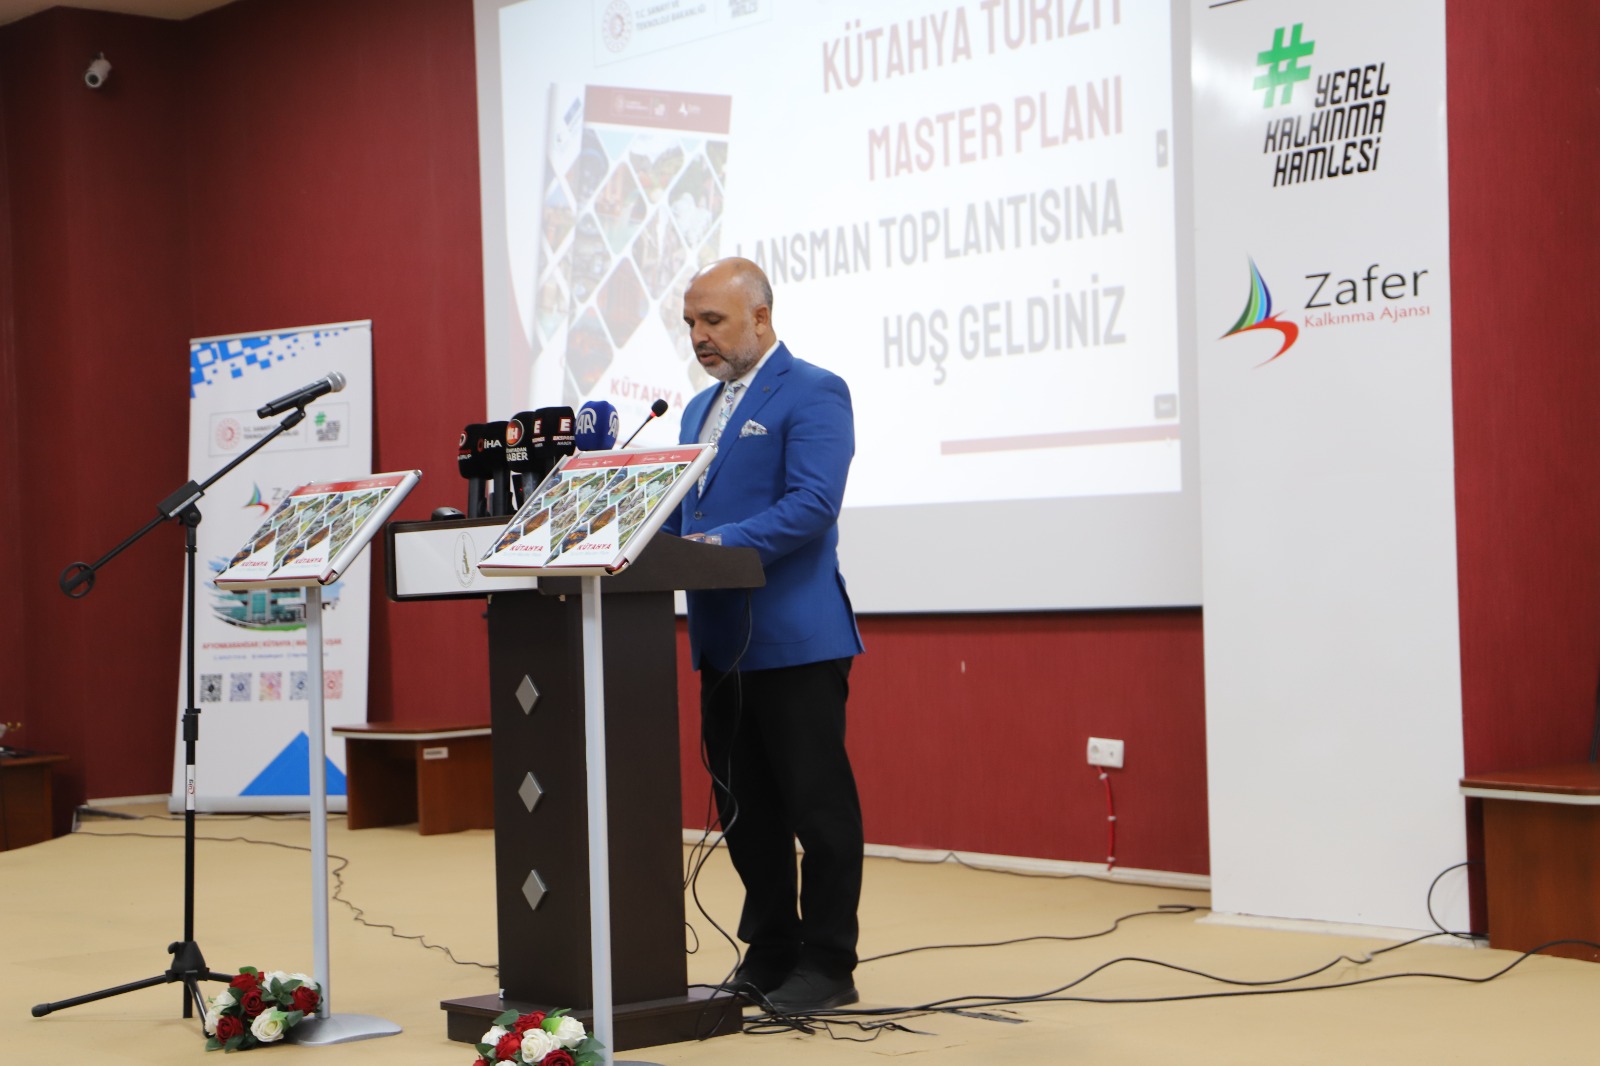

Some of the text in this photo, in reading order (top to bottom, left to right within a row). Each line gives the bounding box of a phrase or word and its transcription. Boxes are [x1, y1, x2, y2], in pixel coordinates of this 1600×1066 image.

[822, 4, 972, 94] KÜTAHYA
[1314, 62, 1390, 108] YEREL
[868, 75, 1124, 182] MASTER PLANI
[1263, 100, 1387, 154] KALKINMA
[1273, 137, 1381, 187] HAMLESİ
[878, 179, 1124, 269] TOPLANTISINA
[1304, 264, 1429, 310] Zafer
[883, 273, 1127, 386] HOŞ GELDİNİZ
[1304, 305, 1431, 328] Kalkınma Ajansı
[610, 376, 683, 410] KÜTAHYA
[483, 438, 503, 449] İHA
[575, 413, 596, 435] AA
[510, 543, 544, 552] KÜTAHYA
[577, 542, 612, 551] KÜTAHYA
